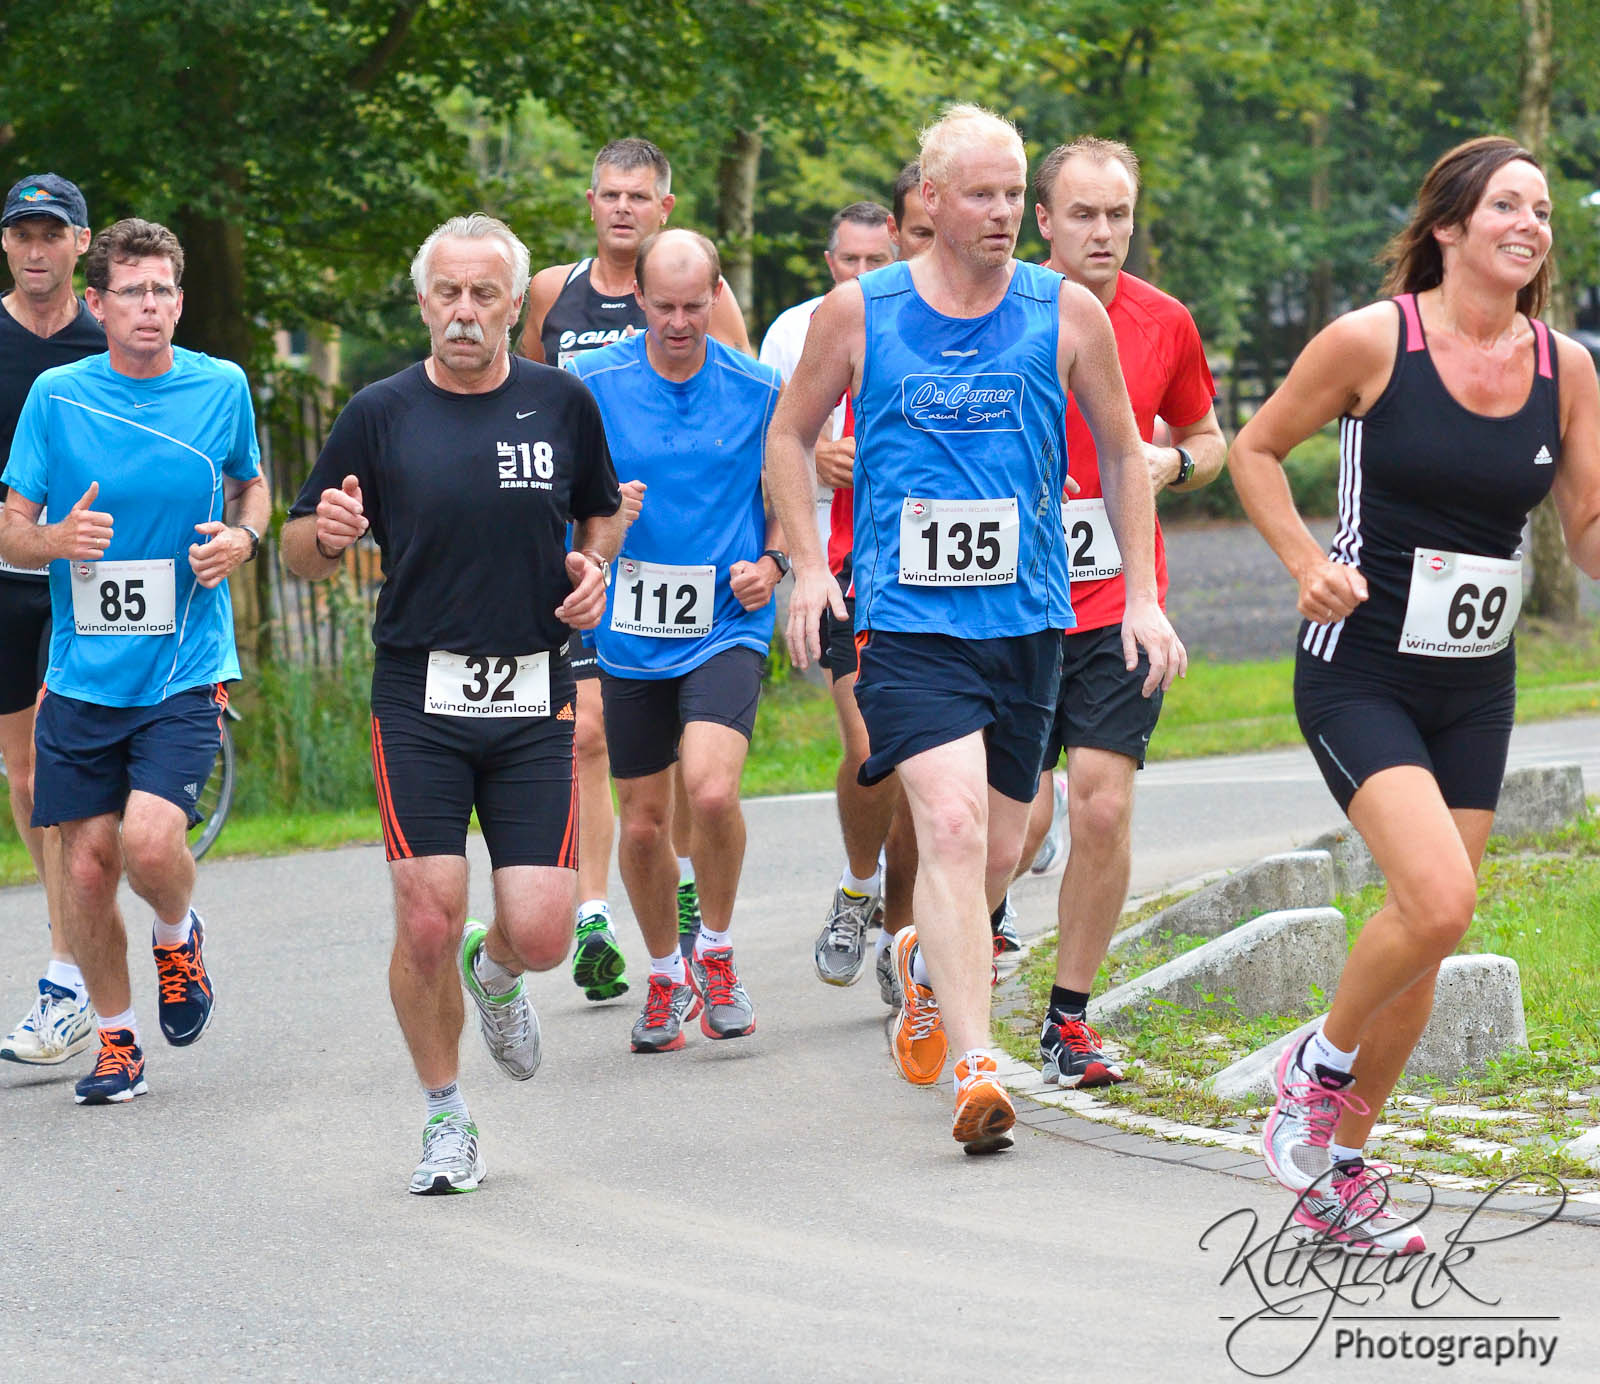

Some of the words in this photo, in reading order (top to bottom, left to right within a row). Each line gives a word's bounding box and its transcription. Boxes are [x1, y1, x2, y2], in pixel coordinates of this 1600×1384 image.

[577, 329, 647, 345] GIA
[910, 382, 945, 409] De
[945, 383, 1016, 410] Corner
[914, 409, 959, 421] Casual
[967, 405, 1012, 424] Sport
[496, 441, 518, 479] KLIF
[516, 441, 554, 480] 18
[499, 481, 529, 489] JEANS
[530, 481, 553, 491] SPORT
[921, 521, 1001, 571] 135
[1062, 520, 1096, 567] 2
[902, 571, 1015, 582] windmolenloop
[1068, 567, 1122, 578] olenloop
[99, 579, 146, 622] 85
[630, 579, 698, 625] 112
[1447, 583, 1508, 640] 69
[77, 623, 174, 633] windmolenloop
[614, 620, 710, 635] windmolenloop
[462, 655, 519, 702] 32
[429, 701, 547, 715] windmolenloop
